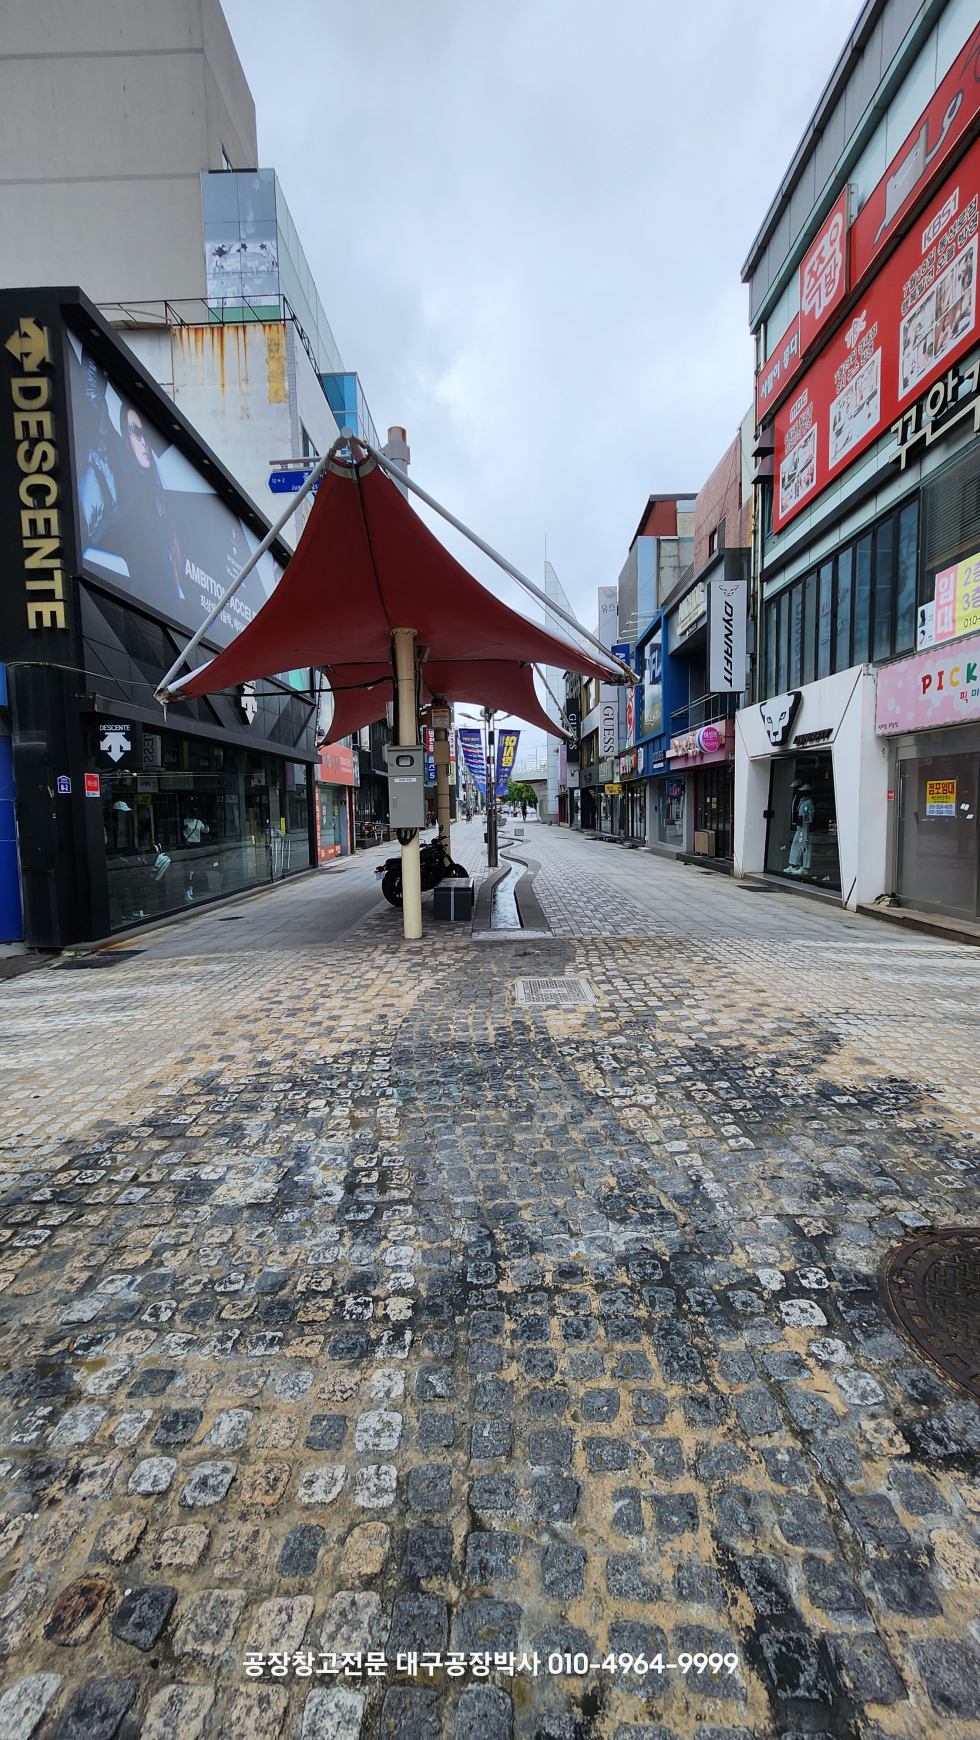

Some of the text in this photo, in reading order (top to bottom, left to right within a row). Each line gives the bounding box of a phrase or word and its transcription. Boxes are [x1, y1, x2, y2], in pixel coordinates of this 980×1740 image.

[923, 189, 959, 252] KBS1
[936, 243, 956, 275] 오늘
[958, 212, 979, 249] 방영
[938, 194, 978, 255] 동성로점
[760, 359, 781, 399] 사람이
[11, 377, 66, 631] DESCENTE
[937, 572, 955, 634] 임대
[722, 600, 734, 688] DYNAFIT
[921, 662, 978, 695] PICK
[602, 706, 615, 753] GUESS
[928, 782, 955, 795] 점포임대
